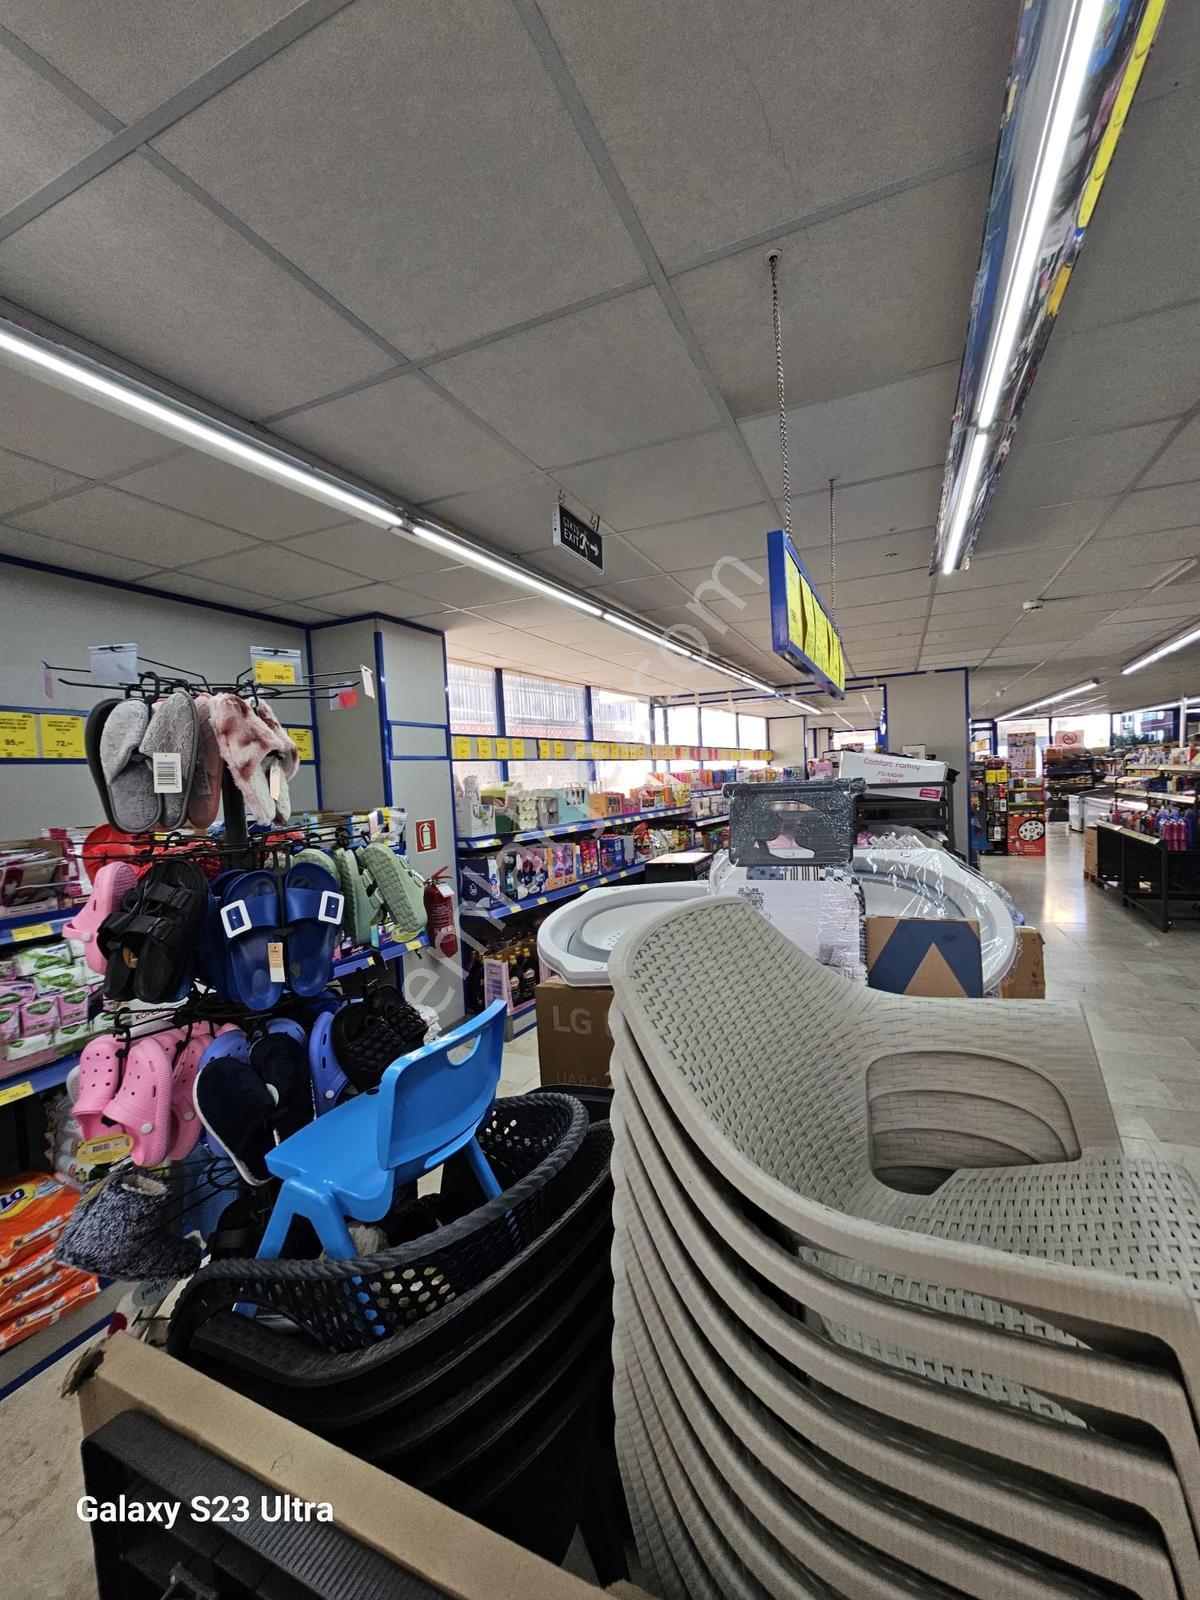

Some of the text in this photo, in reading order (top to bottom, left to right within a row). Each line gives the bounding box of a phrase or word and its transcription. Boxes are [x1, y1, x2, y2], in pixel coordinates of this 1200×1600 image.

[564, 528, 579, 546] EXIT
[863, 758, 921, 771] Comfort Family
[552, 1004, 592, 1036] LG
